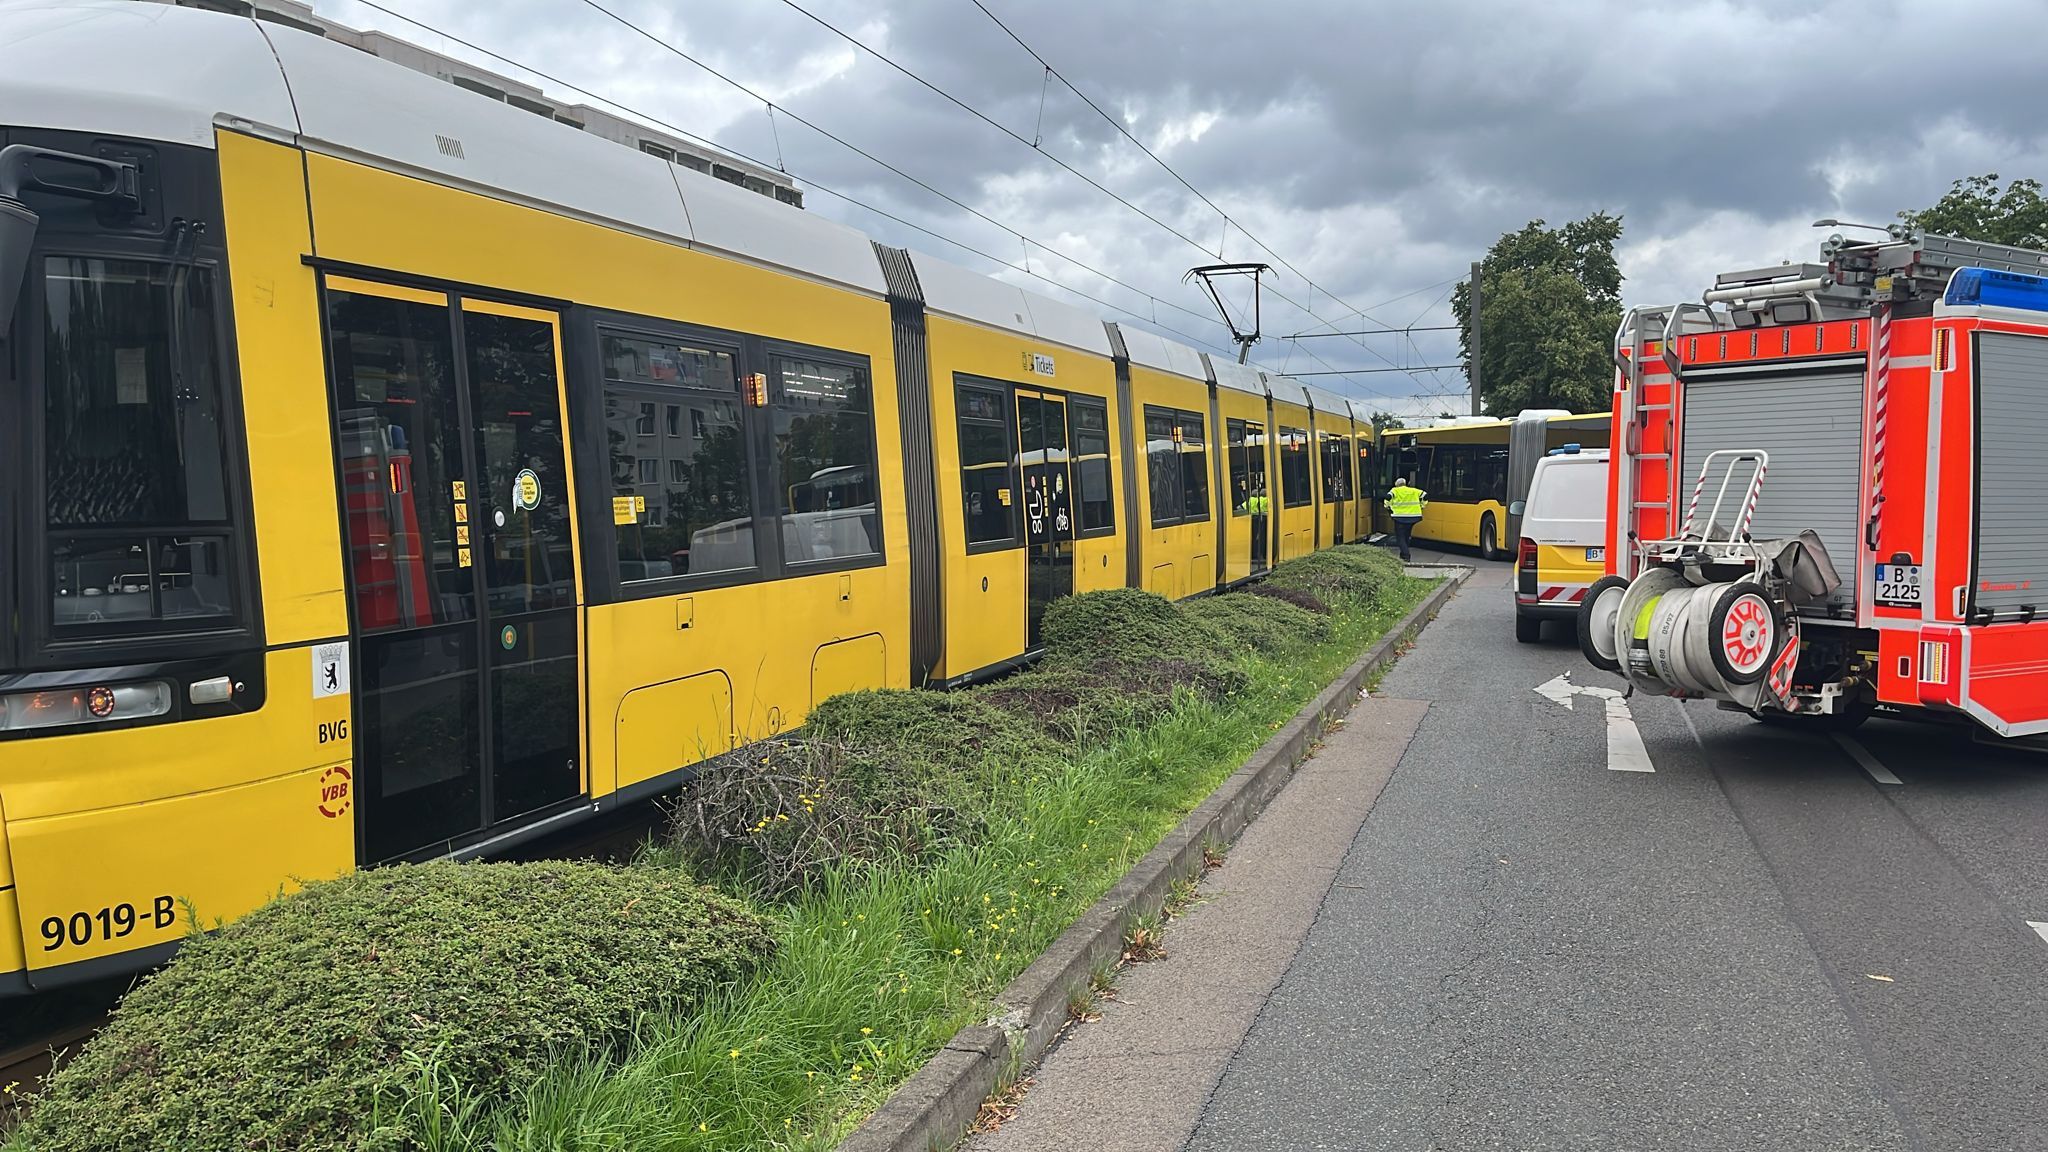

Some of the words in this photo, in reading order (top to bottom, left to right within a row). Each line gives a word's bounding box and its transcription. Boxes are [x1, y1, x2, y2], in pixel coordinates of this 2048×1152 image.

[1035, 356, 1054, 375] Tickets
[1592, 549, 1598, 558] B
[1894, 568, 1904, 582] B
[1881, 583, 1921, 600] 2125
[318, 719, 347, 744] BVG
[321, 782, 348, 803] VBB
[40, 894, 176, 952] 9019-B
